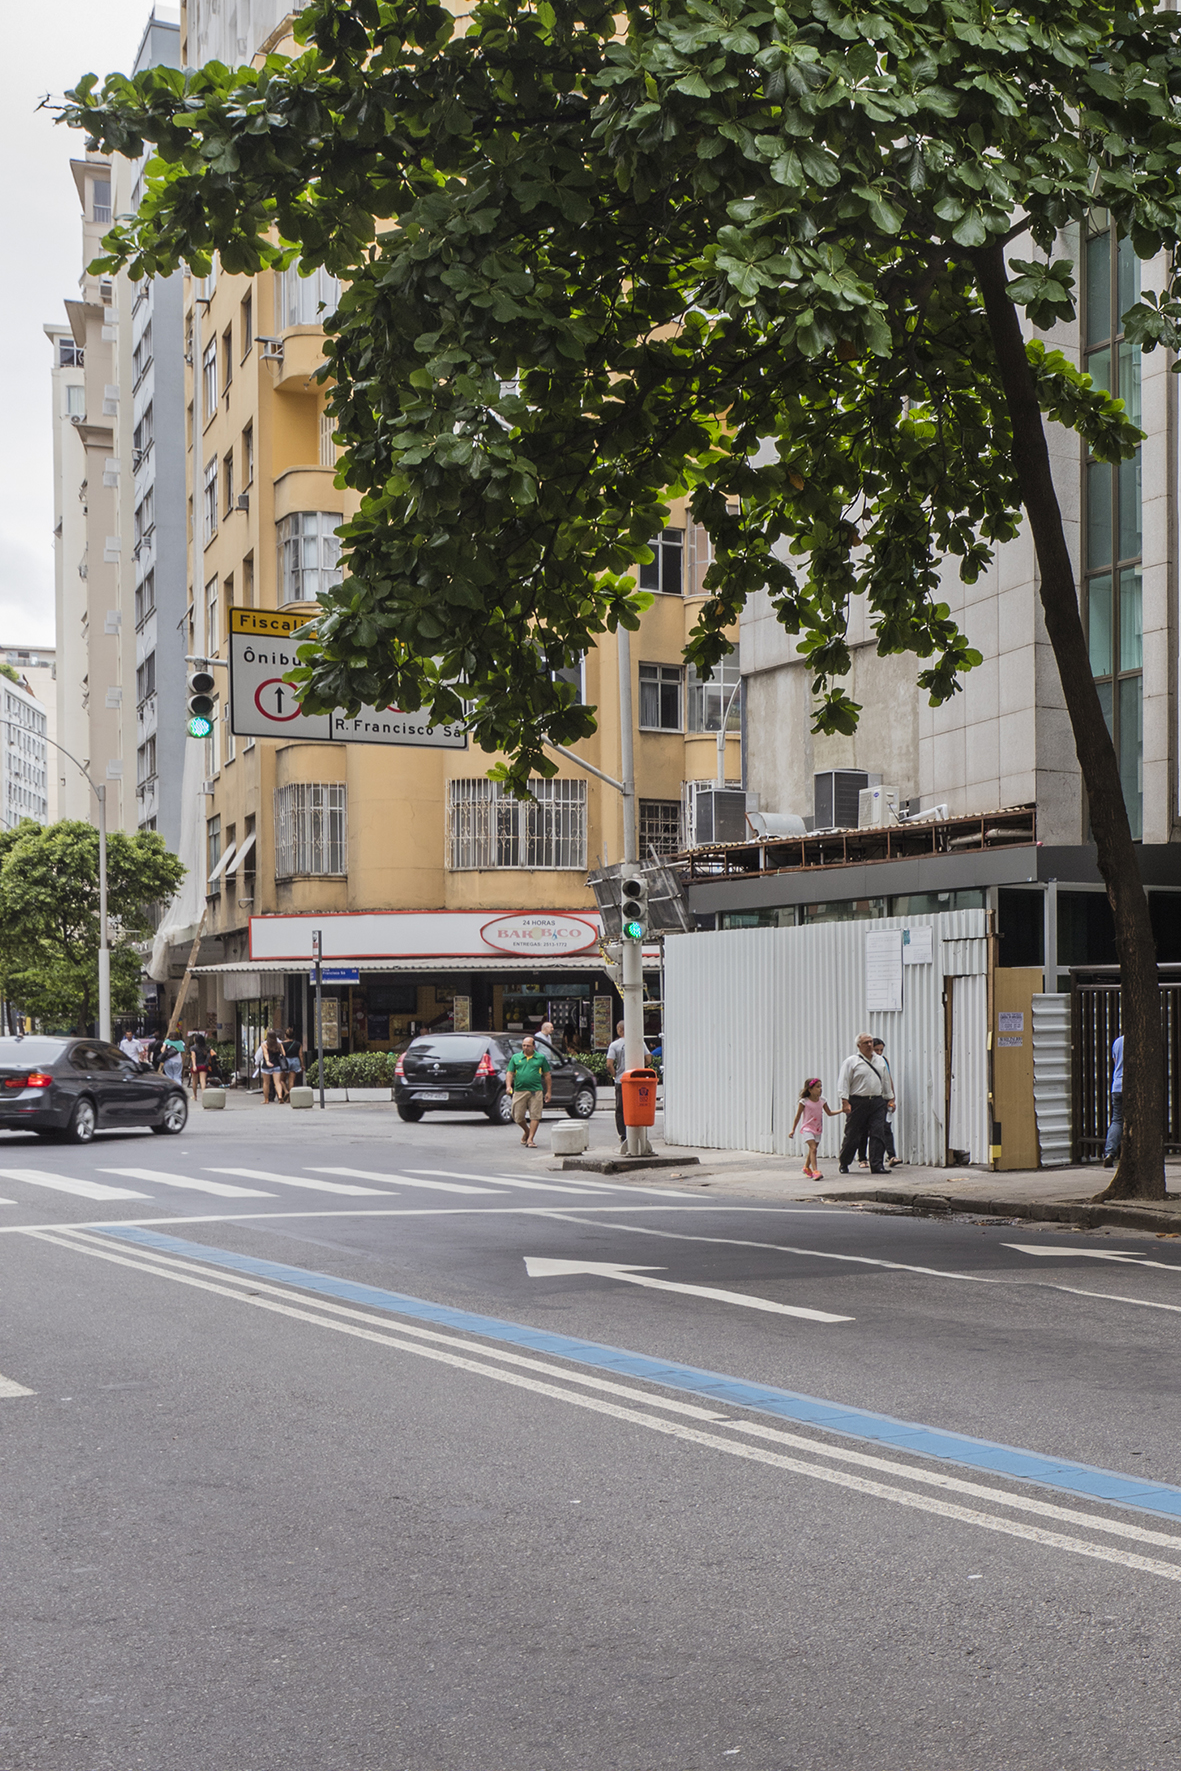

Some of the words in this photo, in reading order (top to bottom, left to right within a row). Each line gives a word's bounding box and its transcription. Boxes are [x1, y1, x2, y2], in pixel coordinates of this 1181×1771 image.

[240, 614, 304, 631] Fiscali
[243, 646, 308, 667] Ônibu
[335, 718, 349, 731] R.
[353, 719, 434, 736] Francisco
[443, 726, 461, 739] Sá
